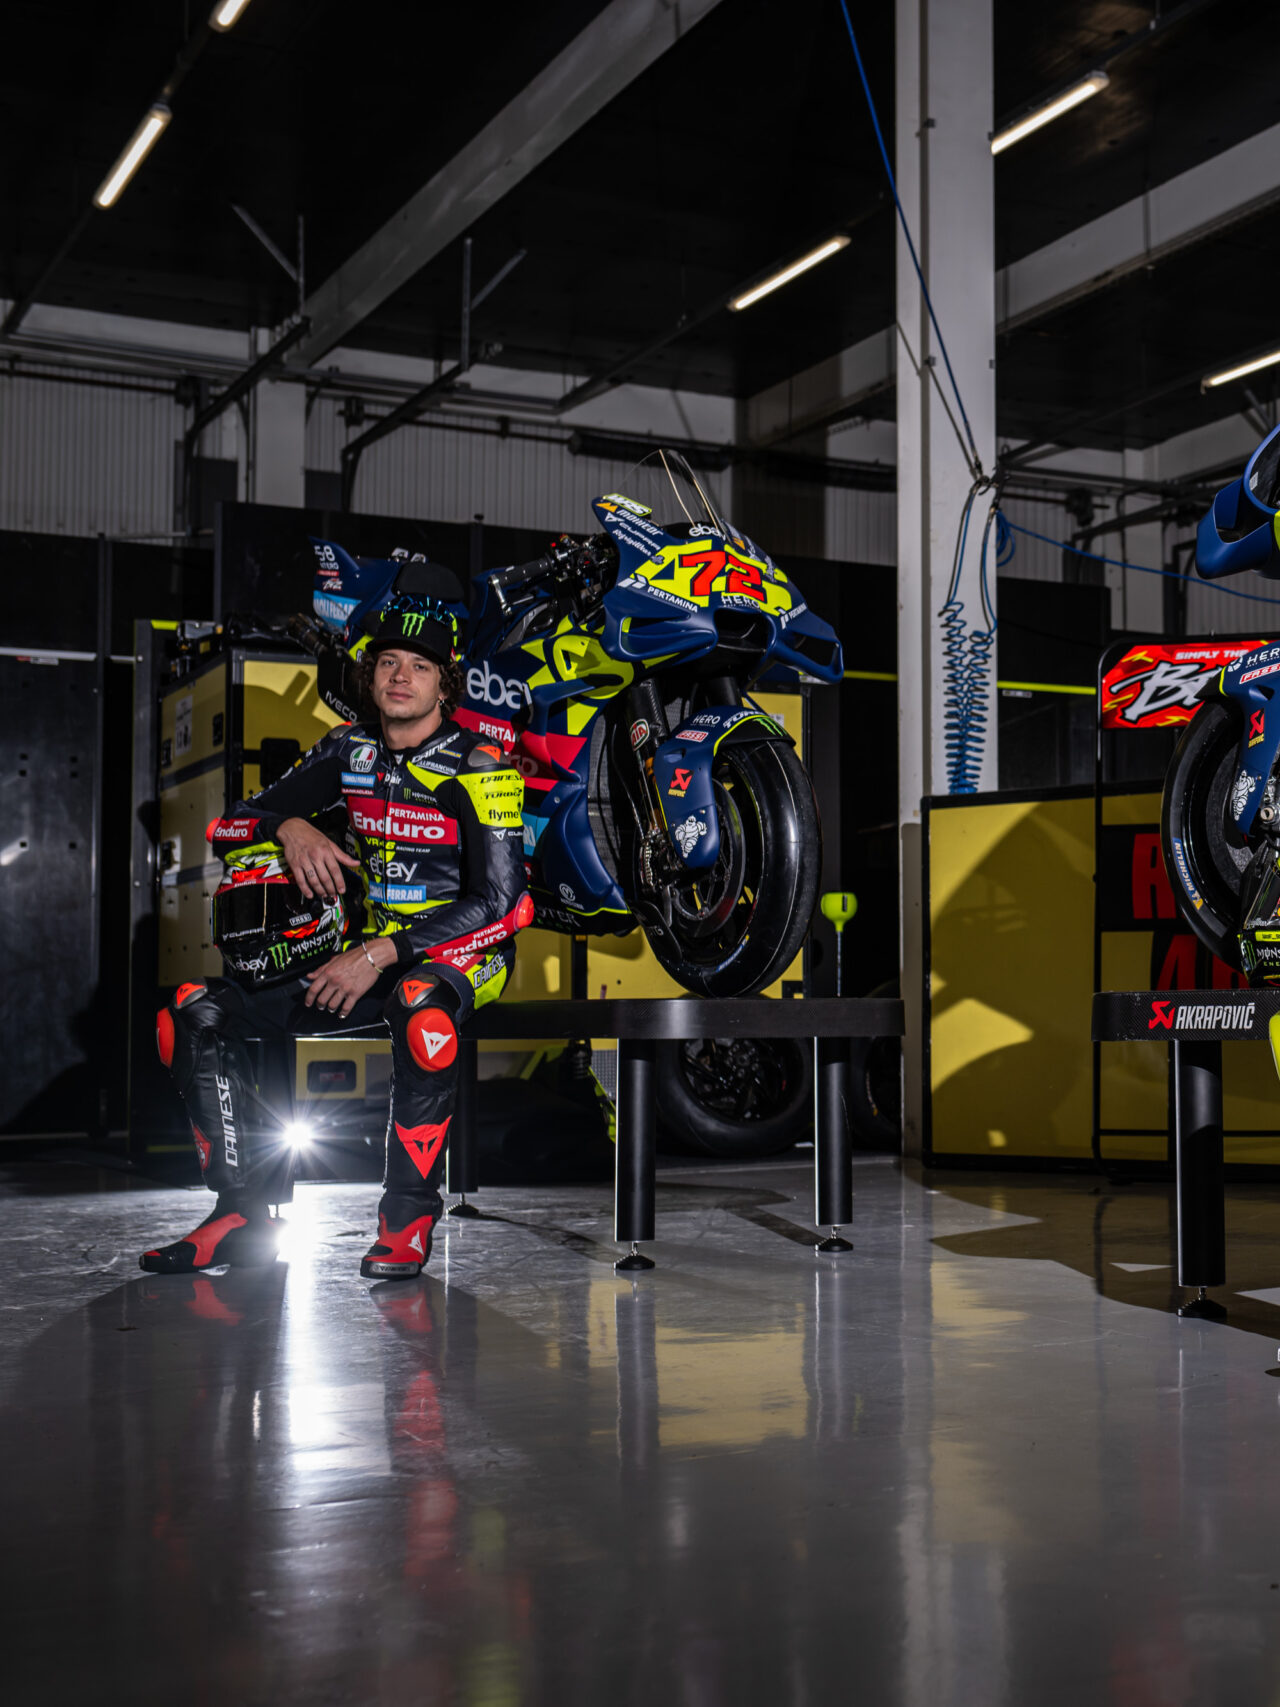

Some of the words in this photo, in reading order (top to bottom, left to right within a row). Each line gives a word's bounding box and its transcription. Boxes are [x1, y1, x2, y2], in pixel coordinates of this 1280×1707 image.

[678, 549, 768, 604] 72
[648, 586, 698, 613] PERTAMINA
[721, 595, 760, 608] HERO
[1175, 652, 1220, 660] SIMPLY
[325, 690, 358, 722] IVECO
[693, 715, 721, 724] HERO
[353, 811, 445, 839] Enduro
[389, 808, 445, 822] PERTAMINA
[488, 808, 519, 819] flyme
[214, 826, 248, 837] Enduro
[369, 853, 418, 882] ebay
[1174, 841, 1195, 893] MICHELIN
[387, 889, 423, 901] FERRARI
[291, 928, 337, 954] MONSTER
[442, 930, 508, 956] Enduro
[473, 922, 504, 940] PERTAMINA
[235, 955, 268, 971] ebay
[473, 953, 506, 988] DAINESE
[216, 1074, 239, 1167] DAINESE
